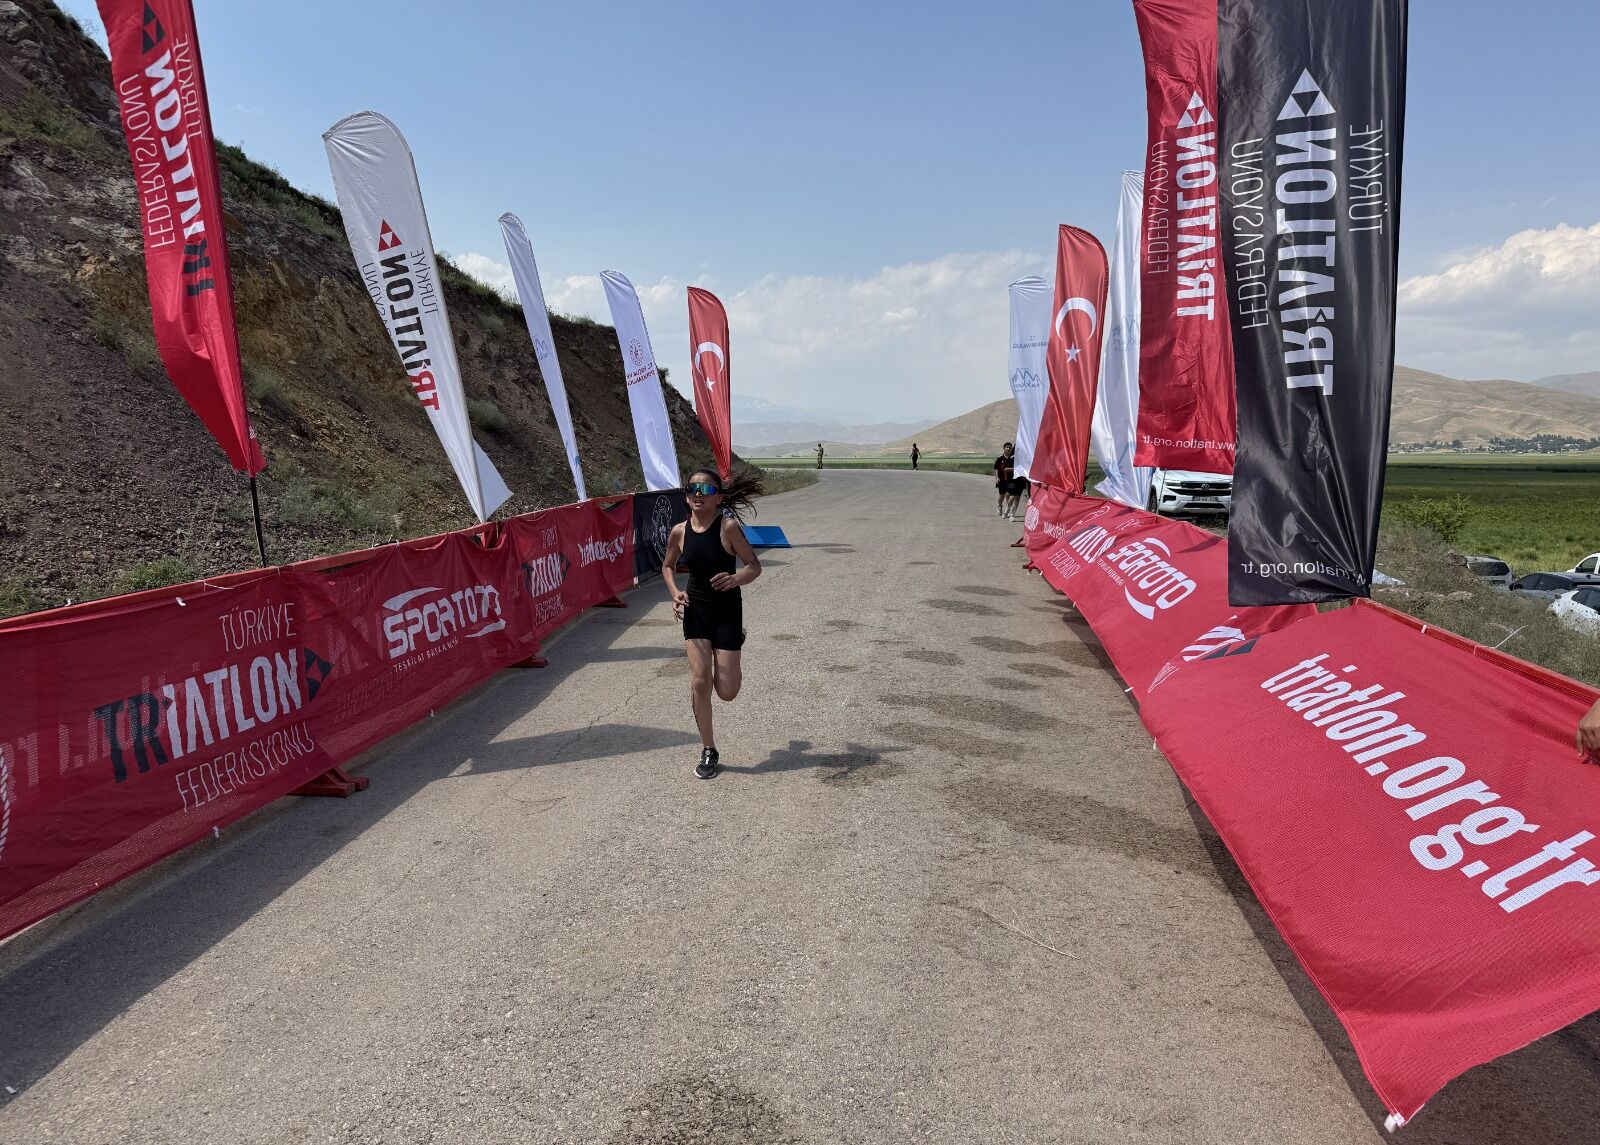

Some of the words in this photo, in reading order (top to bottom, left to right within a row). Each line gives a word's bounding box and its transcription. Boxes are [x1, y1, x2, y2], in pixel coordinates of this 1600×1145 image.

[218, 597, 297, 652] TÜRKİYE
[174, 722, 316, 813] FEDERASYONU
[1260, 653, 1600, 913] triatlon.org.tr
